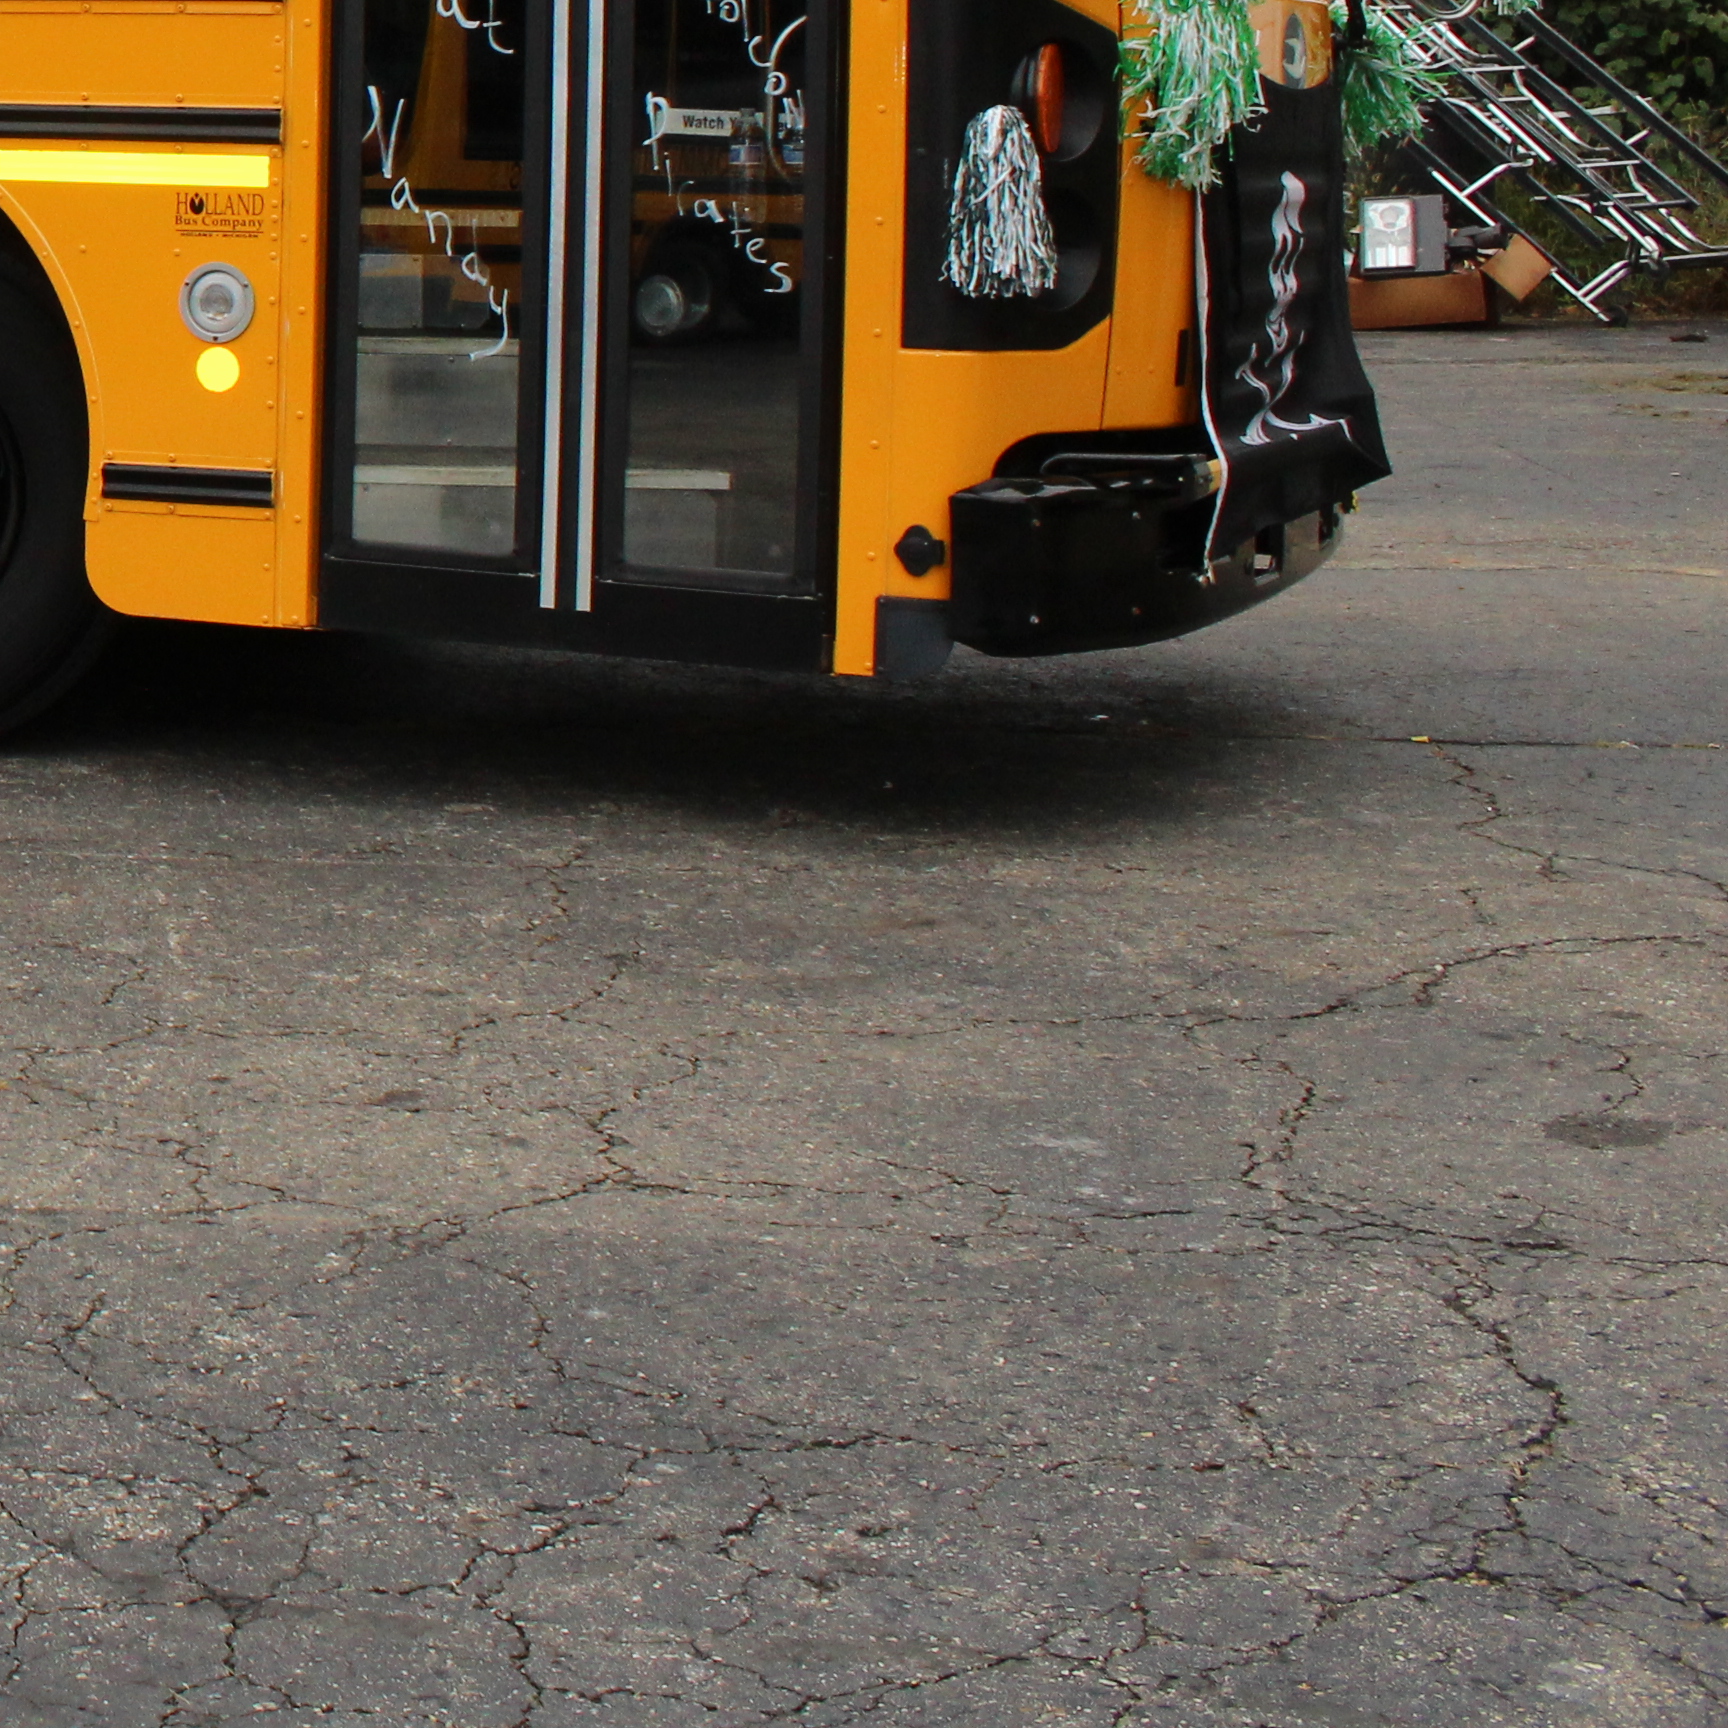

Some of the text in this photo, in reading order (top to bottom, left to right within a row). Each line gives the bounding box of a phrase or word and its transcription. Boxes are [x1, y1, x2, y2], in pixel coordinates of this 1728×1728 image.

[682, 115, 725, 130] Watch
[643, 91, 793, 293] Pirates
[175, 215, 264, 230] Bus Company
